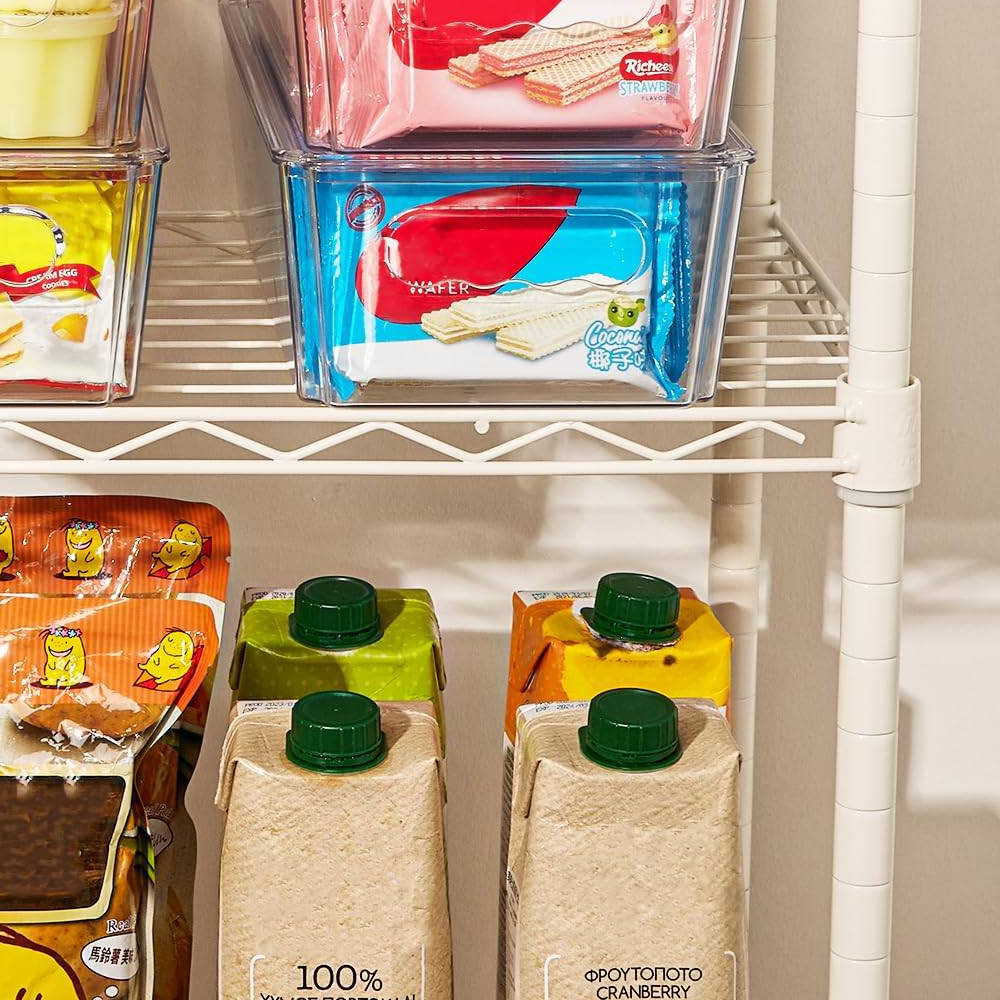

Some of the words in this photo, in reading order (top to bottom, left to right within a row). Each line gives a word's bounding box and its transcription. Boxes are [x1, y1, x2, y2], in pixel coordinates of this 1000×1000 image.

[59, 268, 78, 278] EGG
[408, 280, 470, 295] WAFER
[297, 964, 383, 992] 100%
[584, 967, 703, 983] ΦΡΟΥΤΟΠΟΤΟ
[596, 985, 691, 1000] CRANBERRY
